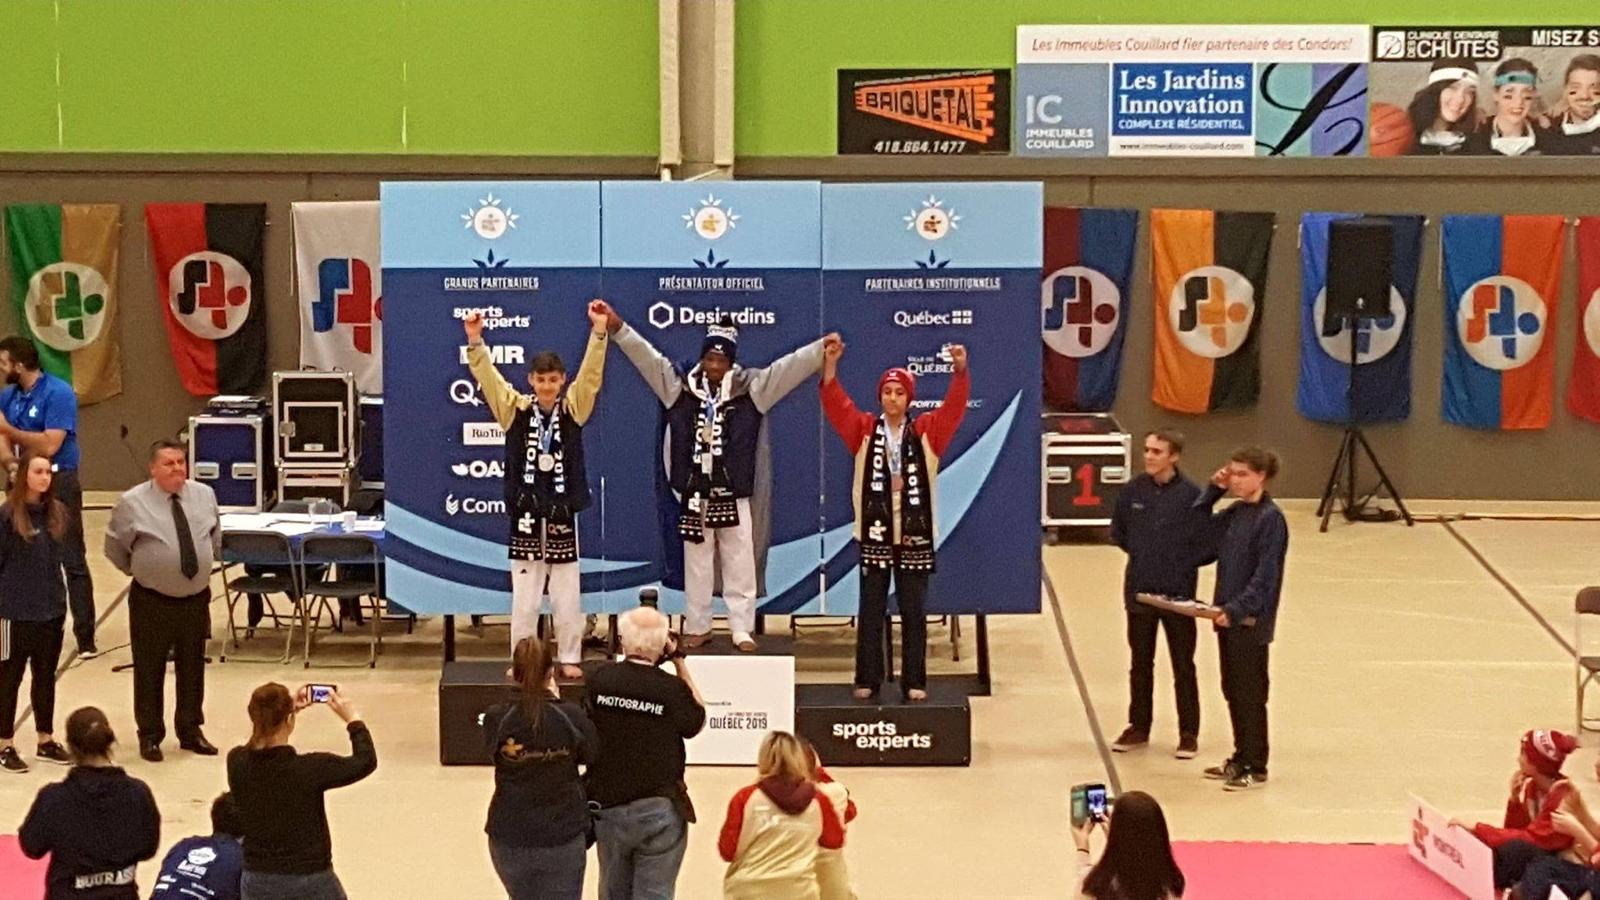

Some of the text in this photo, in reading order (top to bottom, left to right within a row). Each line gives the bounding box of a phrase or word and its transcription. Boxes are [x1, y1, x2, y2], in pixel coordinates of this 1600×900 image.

[1407, 30, 1500, 40] CLINIQUE DENTAIRE
[1531, 30, 1584, 46] MISEZ
[1032, 37, 1353, 53] Les Immeubles Couillard fier partenaire des Condors!
[1416, 39, 1500, 59] CHUTES
[1119, 68, 1246, 93] Les Jardins
[865, 87, 983, 131] BRIQUETAL
[1025, 94, 1063, 125] IC
[1118, 93, 1245, 115] Innovation
[1118, 116, 1245, 130] COMPLEXE RÉSIDENTIEL
[1026, 127, 1094, 139] IMMEUBLES
[1025, 138, 1095, 150] COUILLARD
[444, 277, 540, 289] GRANDS PARTENAIRES
[658, 275, 765, 290] PRÉSENTATEUR OFFICIEL
[865, 276, 1001, 290] PARTENAIRES INSTITUTIONNELS
[893, 310, 951, 328] Québec
[1071, 463, 1103, 507] 1
[596, 694, 666, 716] PHOTOGRAPHE
[709, 715, 769, 730] QUÉBEC 2019
[832, 720, 897, 740] sports
[855, 732, 932, 752] experts
